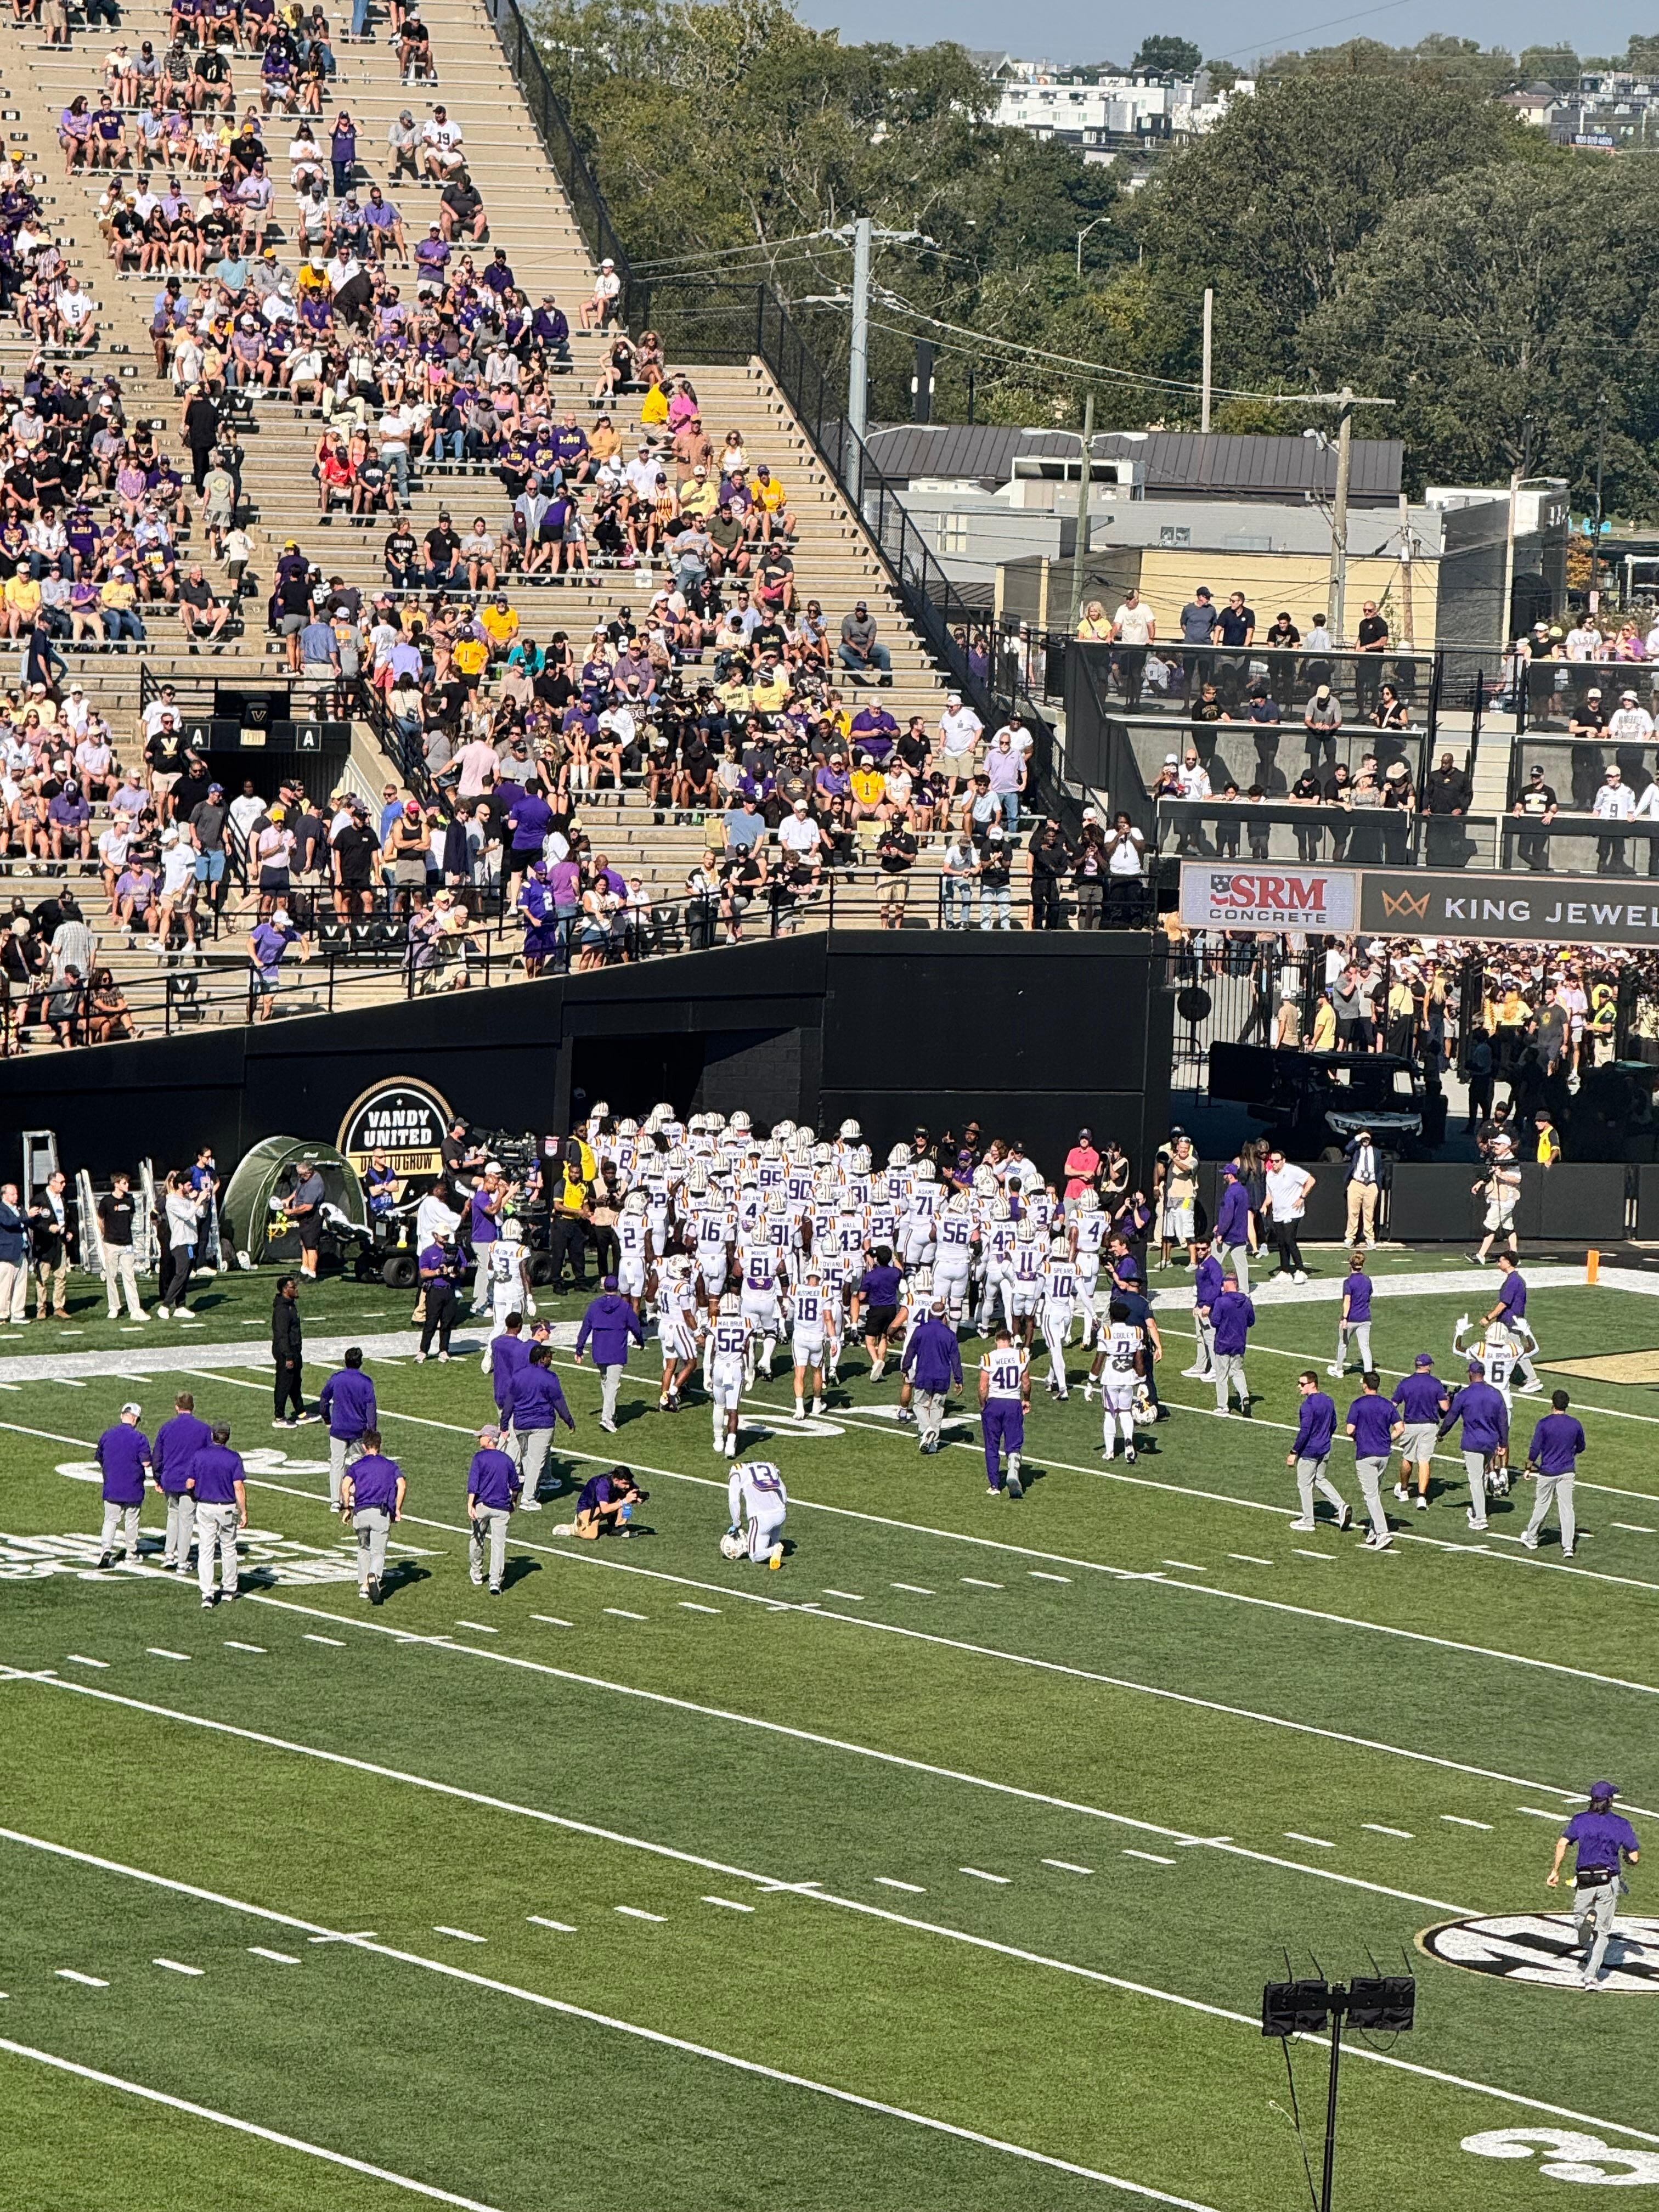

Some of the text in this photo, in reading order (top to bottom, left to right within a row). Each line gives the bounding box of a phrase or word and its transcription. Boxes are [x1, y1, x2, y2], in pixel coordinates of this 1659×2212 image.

[438, 131, 450, 144] 19
[71, 304, 80, 318] 5
[235, 398, 246, 409] V
[704, 606, 710, 619] 1
[618, 635, 629, 652] 2
[735, 714, 746, 724] V
[192, 728, 204, 745] A
[303, 729, 314, 747] A
[753, 785, 763, 800] 3
[865, 782, 870, 795] 1
[1610, 803, 1618, 818] 9
[543, 891, 553, 911] 2
[1228, 873, 1327, 911] SRM
[658, 911, 671, 922] V
[1210, 908, 1327, 924] CONCRETE
[1445, 897, 1530, 921] KING
[325, 925, 337, 937] V
[356, 925, 369, 937] V
[386, 926, 399, 937] V
[176, 980, 190, 991] V
[368, 1109, 430, 1128] VANDY
[364, 1128, 432, 1147] UNITED
[403, 1155, 432, 1170] GROW
[619, 1150, 631, 1169] 8
[760, 1170, 782, 1187] 95
[789, 1179, 812, 1200] 90
[746, 1203, 757, 1218] 4
[915, 1197, 933, 1215] 71
[1036, 1206, 1048, 1224] 3
[701, 1219, 721, 1242] 16
[771, 1224, 789, 1246] 91
[872, 1217, 895, 1237] 23
[943, 1222, 968, 1244] 56
[1088, 1221, 1099, 1242] 4
[624, 1228, 636, 1249] 2
[499, 1257, 510, 1272] 3
[750, 1257, 769, 1277] 61
[1020, 1251, 1032, 1272] 11
[1053, 1276, 1071, 1297] 10
[660, 1291, 670, 1314] 11
[797, 1298, 817, 1321] 18
[718, 1328, 744, 1352] 52
[992, 1365, 1019, 1390] 40
[1491, 1361, 1504, 1383] 6
[748, 1465, 774, 1482] 13
